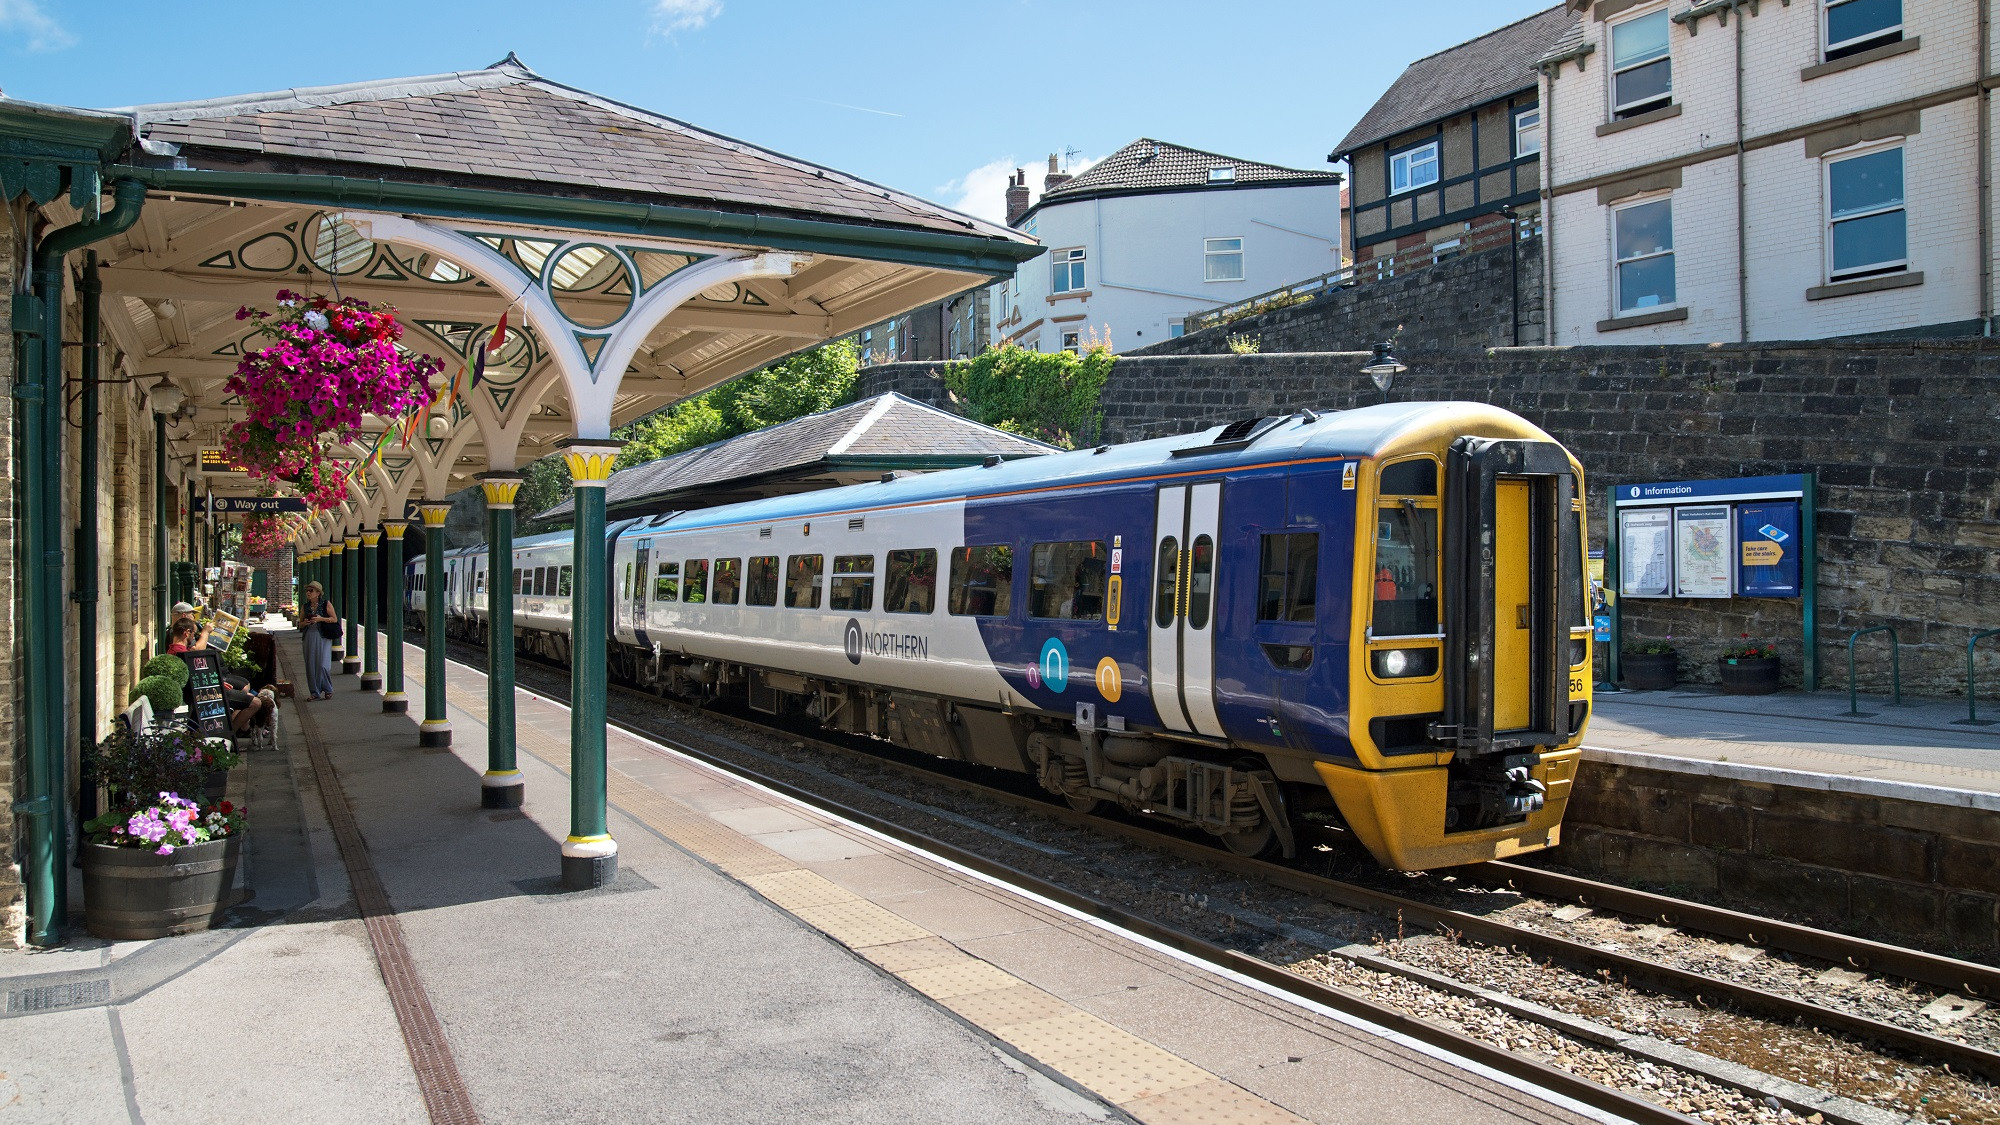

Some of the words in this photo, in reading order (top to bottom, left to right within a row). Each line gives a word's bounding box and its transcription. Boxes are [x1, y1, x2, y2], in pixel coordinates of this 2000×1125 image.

[1644, 485, 1692, 496] Information
[234, 501, 257, 510] Way
[260, 501, 280, 509] out
[408, 503, 420, 521] 2
[865, 632, 928, 661] NORTHERN
[1570, 679, 1582, 692] 56
